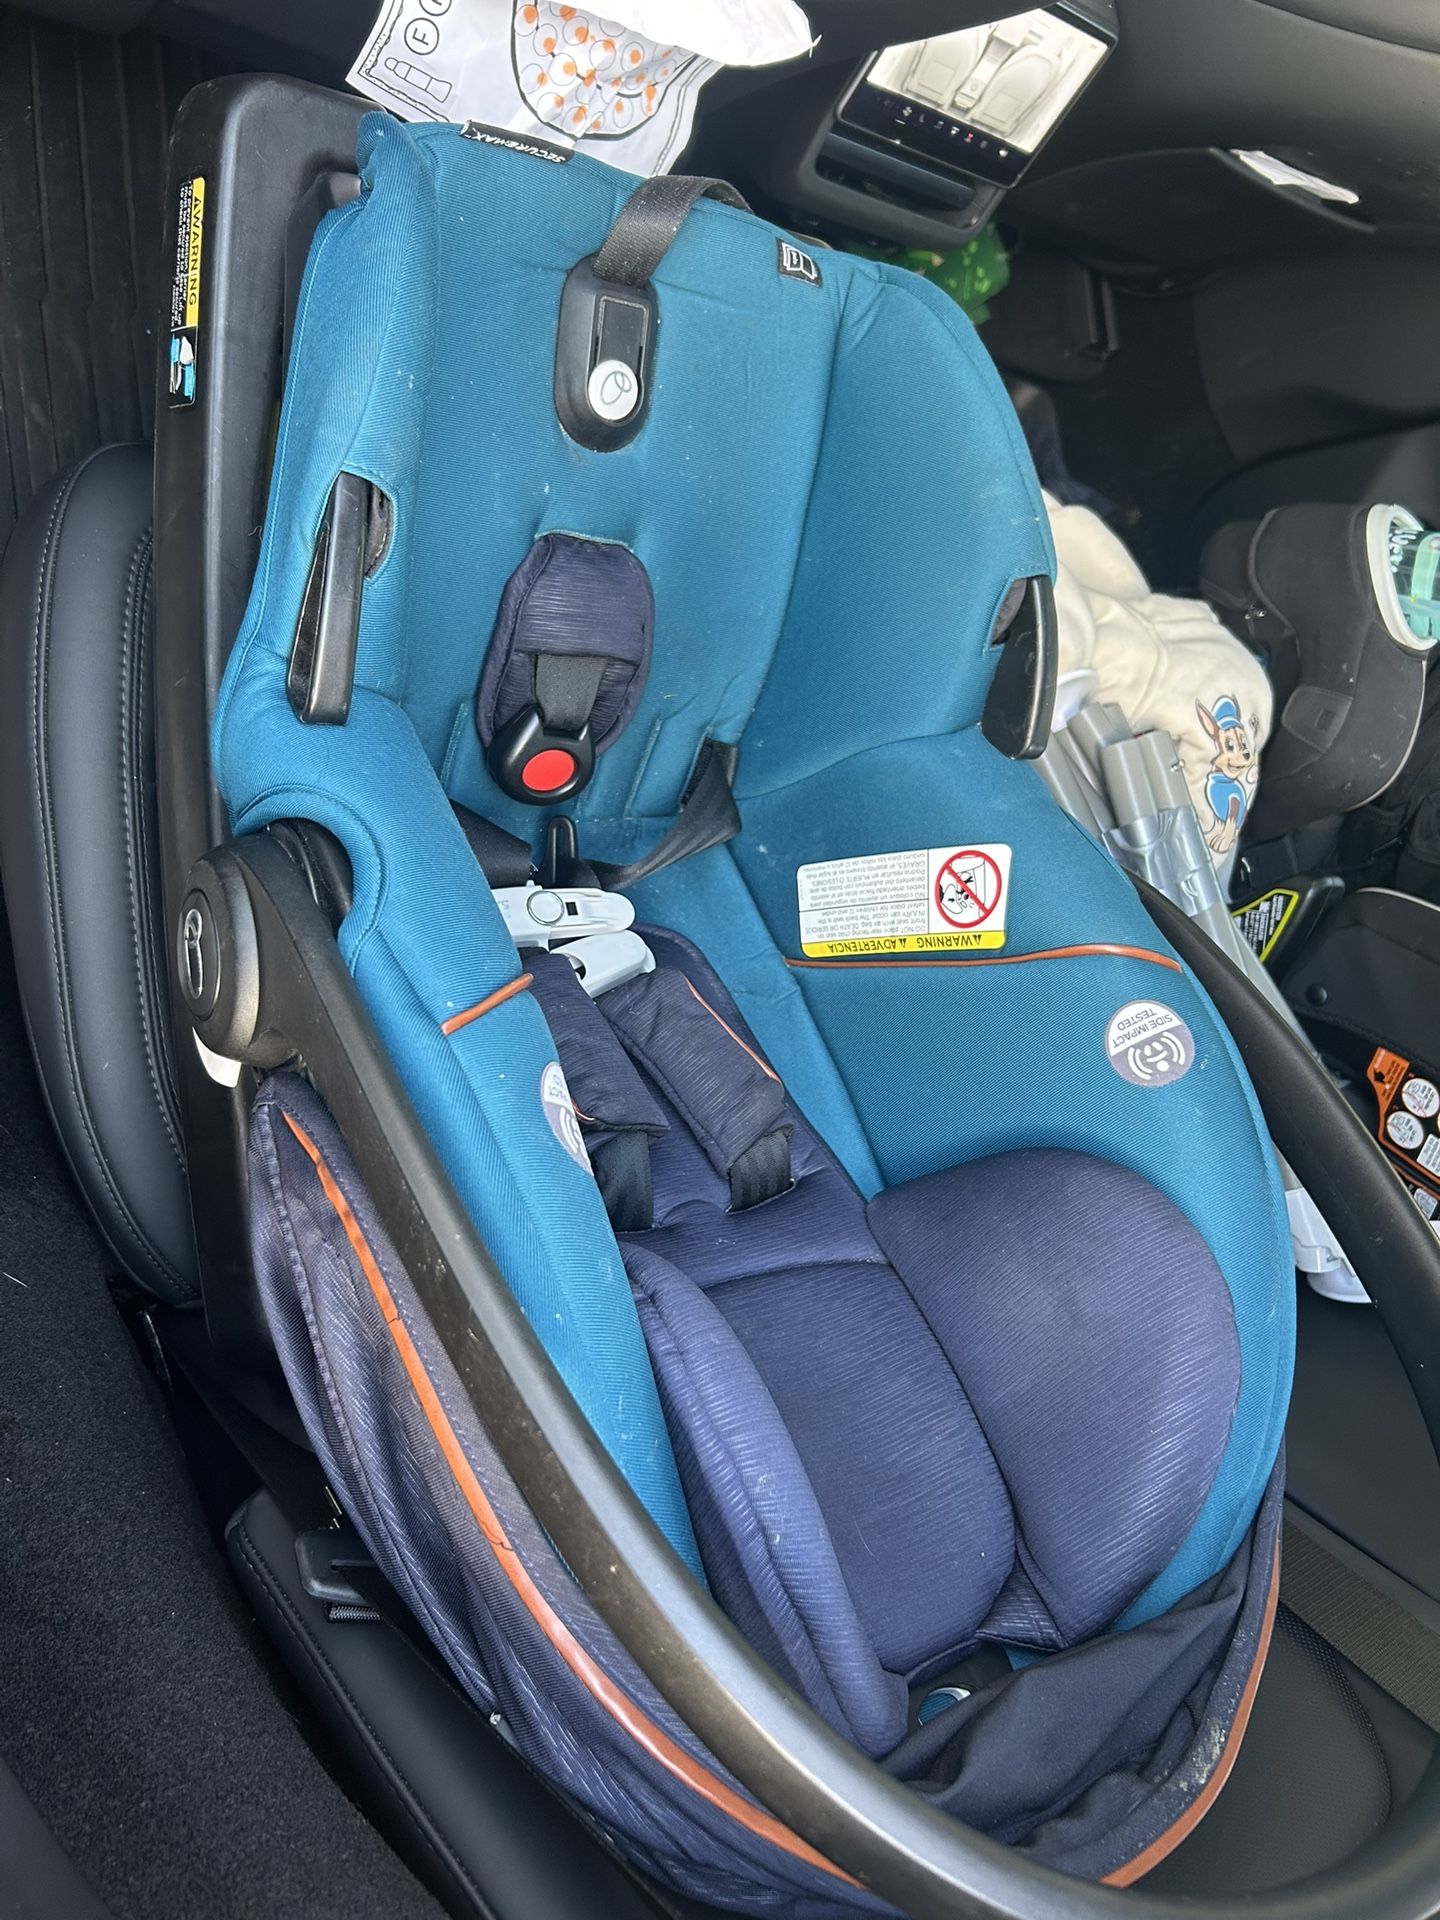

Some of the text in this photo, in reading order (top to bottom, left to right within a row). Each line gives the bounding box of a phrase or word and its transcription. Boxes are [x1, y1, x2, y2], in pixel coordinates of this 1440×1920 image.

[412, 27, 429, 46] F
[188, 209, 200, 305] WARNING
[828, 934, 972, 953] WARNING ADVERTENCIA
[1111, 1014, 1173, 1048] SIDE IMPACT
[1117, 1008, 1157, 1031] TESTED
